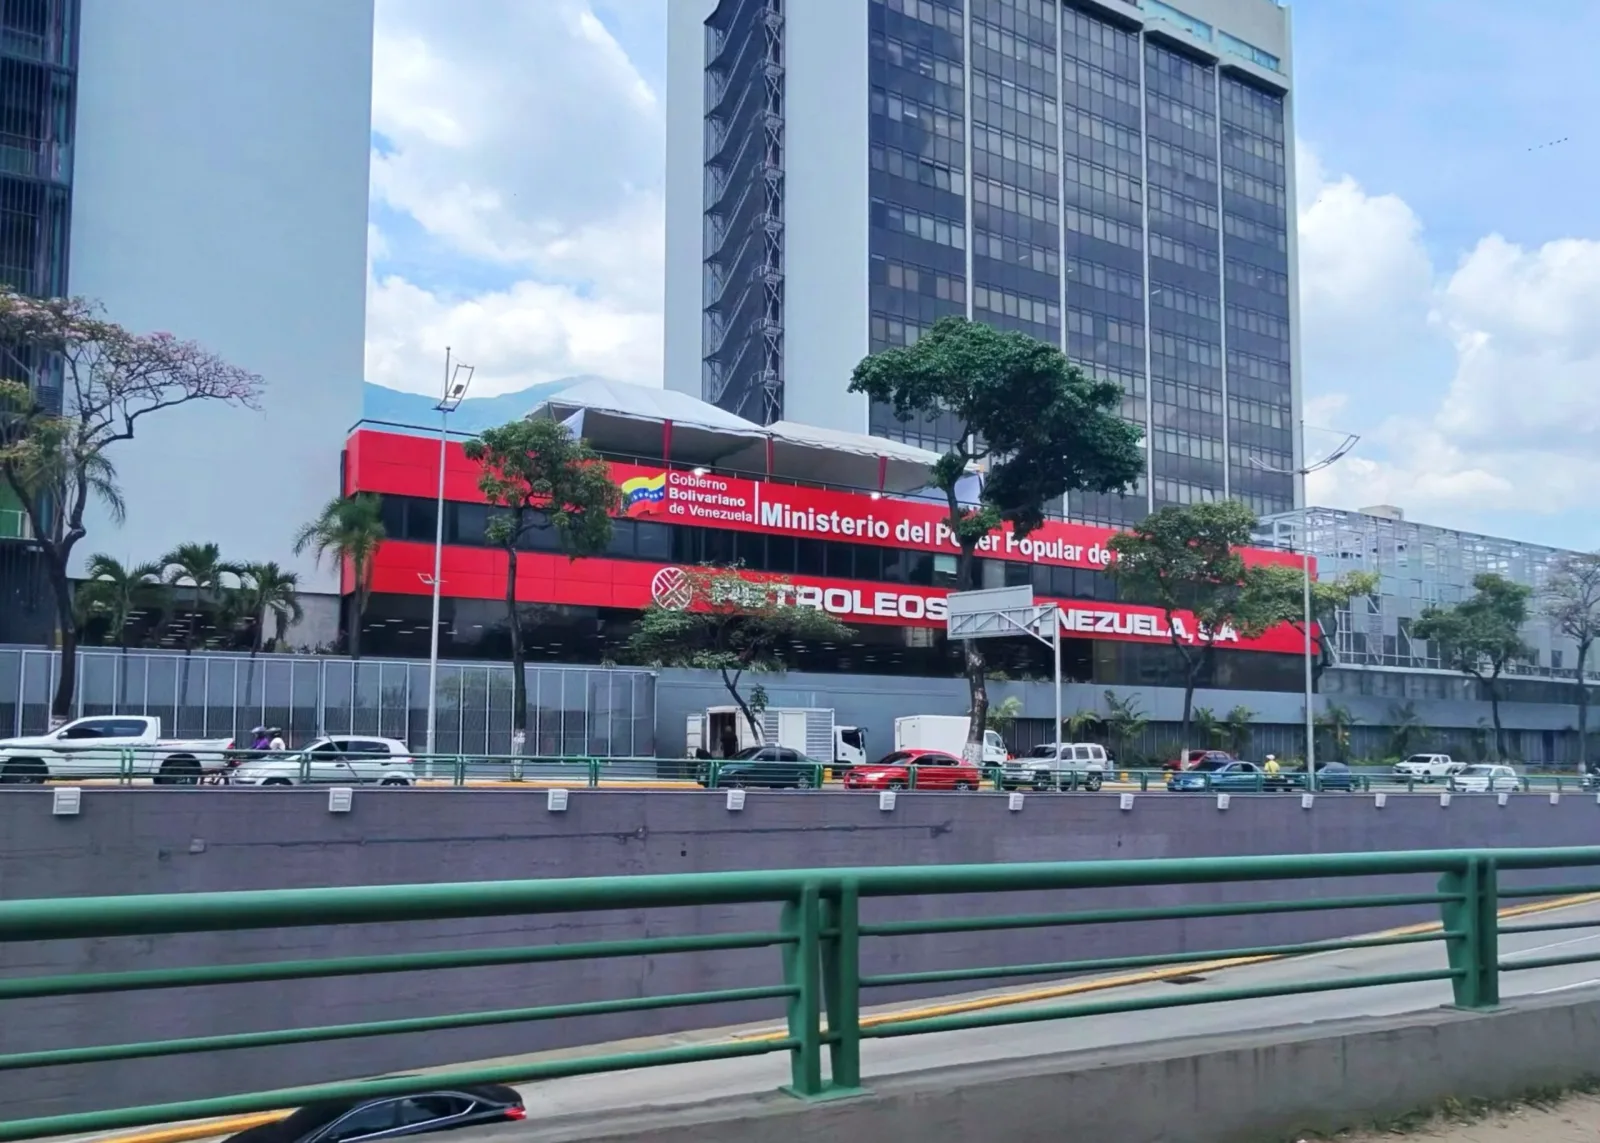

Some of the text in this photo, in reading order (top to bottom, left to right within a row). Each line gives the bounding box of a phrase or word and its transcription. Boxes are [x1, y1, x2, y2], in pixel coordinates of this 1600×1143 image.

[669, 472, 727, 491] Gobierno
[669, 487, 746, 508] Bolivariano
[669, 502, 753, 523] de Venezuela
[760, 501, 890, 540] Ministerio
[895, 518, 931, 545] del
[935, 522, 1001, 552] Poer
[1005, 530, 1084, 562] Popular
[1088, 542, 1111, 566] de
[1057, 606, 1195, 644] NEZUELA,
